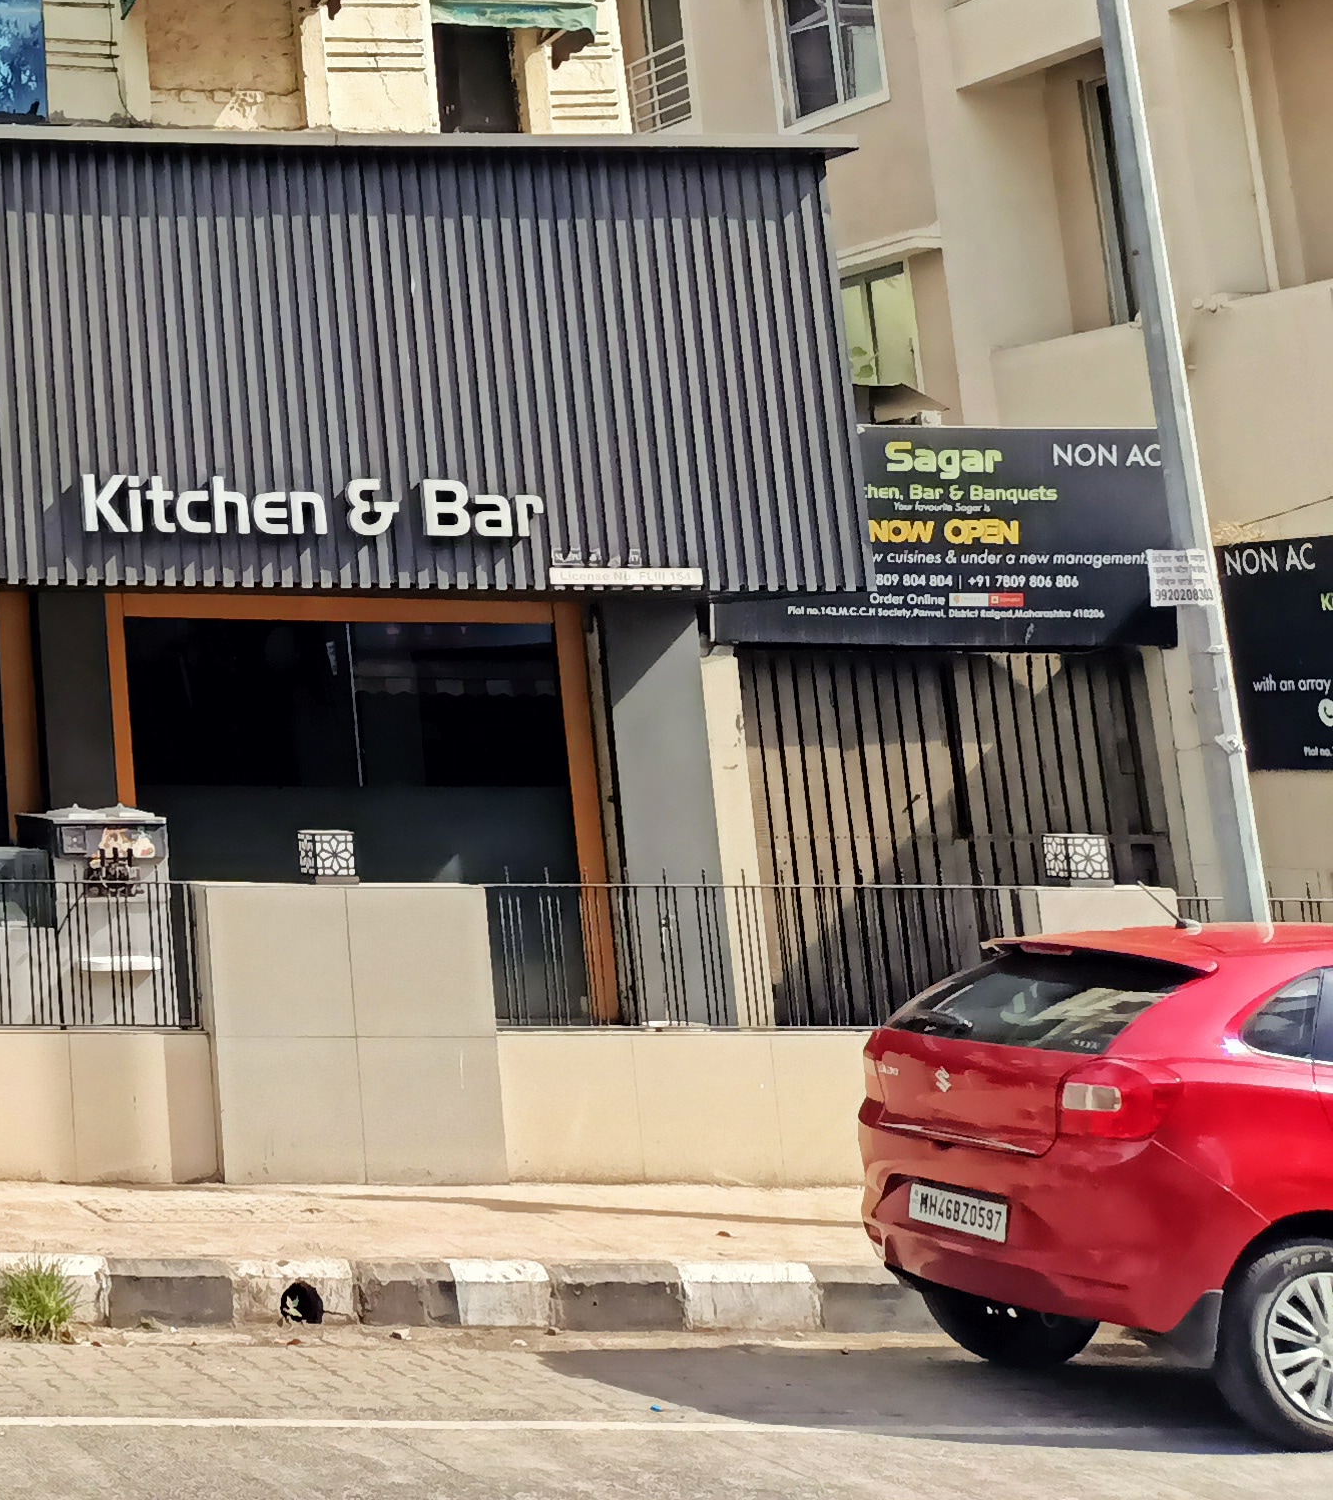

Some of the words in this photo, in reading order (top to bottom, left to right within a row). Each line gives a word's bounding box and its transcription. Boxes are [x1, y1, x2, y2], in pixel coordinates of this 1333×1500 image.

[884, 441, 1003, 480] Sagar
[1052, 443, 1118, 467] NON
[1125, 443, 1162, 467] AC
[864, 484, 904, 501] hen,
[909, 484, 944, 501] Bar
[949, 484, 965, 501] &
[969, 485, 1058, 504] Banquets
[81, 473, 328, 536] Kitchen
[347, 477, 400, 537] &
[422, 478, 544, 538] Bar
[868, 519, 934, 544] NOW
[944, 518, 1021, 545] OPEN
[886, 550, 942, 564] cuisines
[945, 550, 957, 564] &
[960, 550, 1001, 564] under
[1005, 554, 1016, 565] a
[1018, 553, 1050, 565] new
[1224, 547, 1279, 576] NON
[1285, 543, 1316, 572] AC
[560, 570, 610, 581] License
[875, 574, 899, 586] 809
[903, 574, 926, 587] 804
[929, 574, 953, 587] 804
[967, 575, 990, 587] +91
[995, 575, 1026, 588] 7809
[1029, 575, 1052, 588] 806
[1055, 575, 1079, 588] 806
[869, 592, 904, 605] Order
[906, 592, 946, 605] Online
[1252, 673, 1277, 692] with
[1279, 679, 1295, 691] an
[1298, 678, 1332, 694] array
[918, 1191, 1003, 1233] MH46BZ0597
